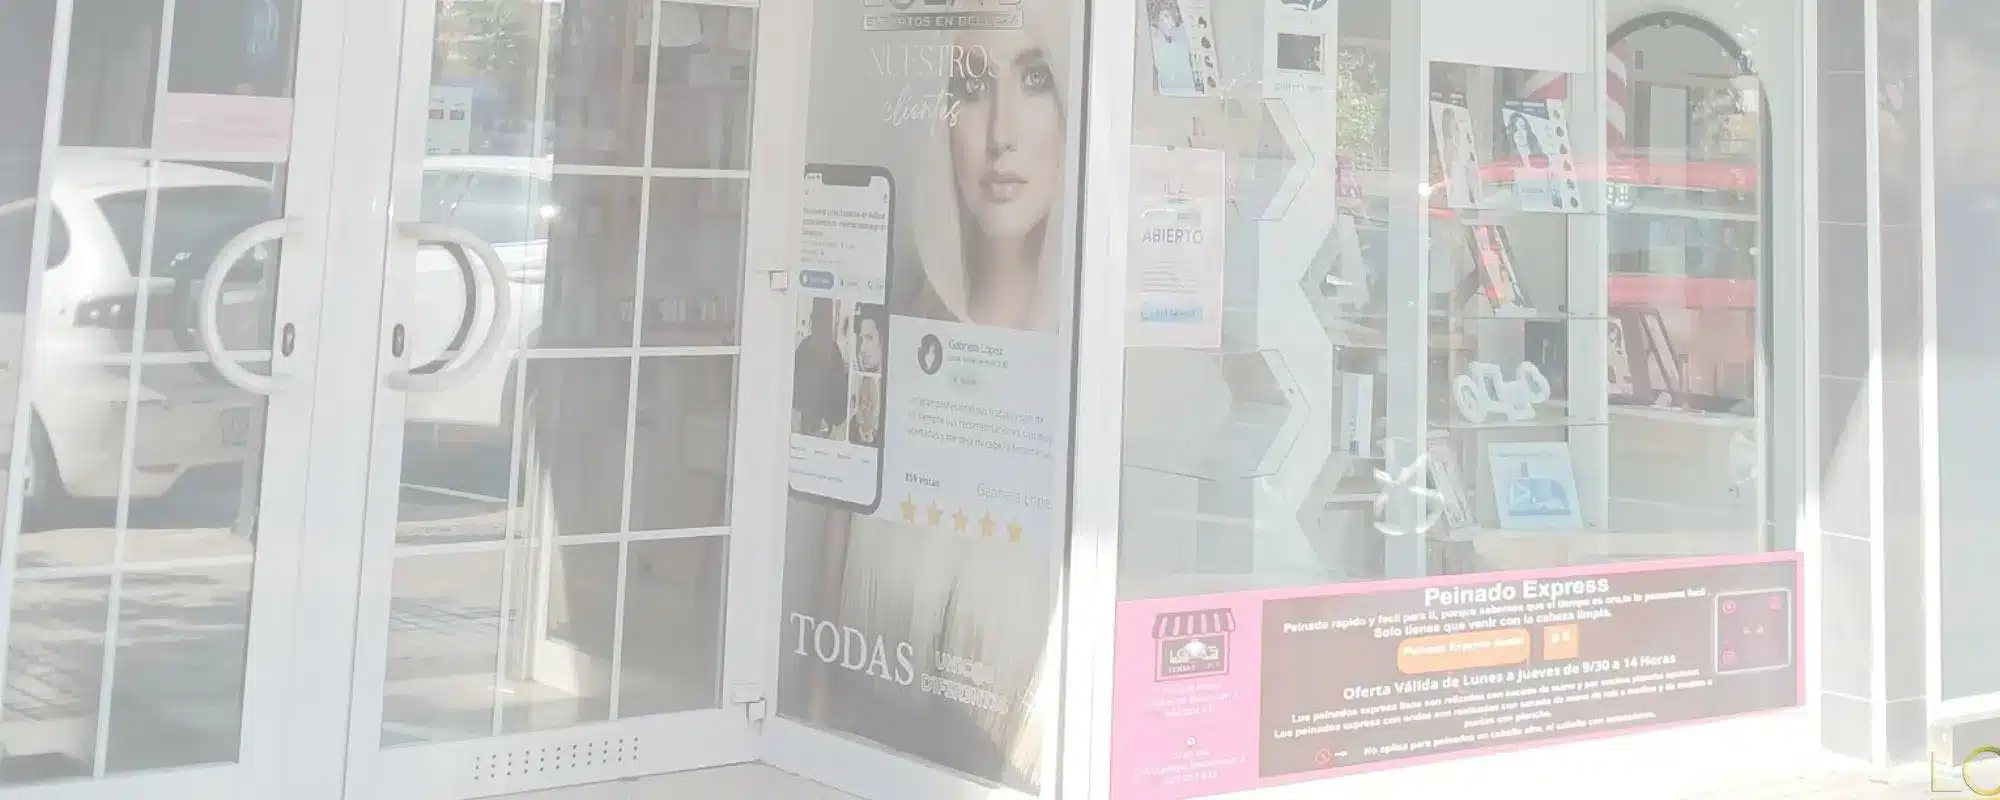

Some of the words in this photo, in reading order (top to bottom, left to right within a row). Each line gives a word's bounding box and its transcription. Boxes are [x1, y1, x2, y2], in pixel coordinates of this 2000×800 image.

[936, 16, 953, 27] EN
[869, 43, 1000, 79] NUESTROS
[881, 84, 962, 134] clientes
[1142, 228, 1204, 244] ABIERTO
[1424, 583, 1516, 606] Peinado
[1522, 578, 1610, 599] Express
[1283, 620, 1329, 633] Peinado
[1367, 615, 1375, 627] y
[1526, 602, 1544, 613] que
[1373, 626, 1402, 639] Solo
[1404, 623, 1440, 637] tienes
[1442, 622, 1466, 634] que
[1467, 617, 1496, 630] venir
[1499, 615, 1521, 627] con
[1523, 613, 1534, 625] la
[1536, 610, 1576, 623] cabeza
[789, 611, 915, 687] TODAS
[1343, 684, 1391, 700] Oferta
[1394, 677, 1438, 693] Válida
[1442, 676, 1460, 689] de
[1463, 672, 1503, 686] Lunes
[1506, 672, 1514, 682] a
[1563, 663, 1580, 676] de
[1583, 659, 1610, 672] 9/30
[1612, 660, 1620, 670] a
[1624, 655, 1638, 668] 14
[1640, 653, 1676, 666] Horas
[1291, 713, 1311, 724] Los
[1313, 708, 1359, 722] peinados
[1424, 697, 1441, 707] son
[1273, 728, 1293, 739] Los
[1295, 722, 1341, 738] peinados
[1383, 715, 1401, 725] con
[1364, 745, 1378, 756] No
